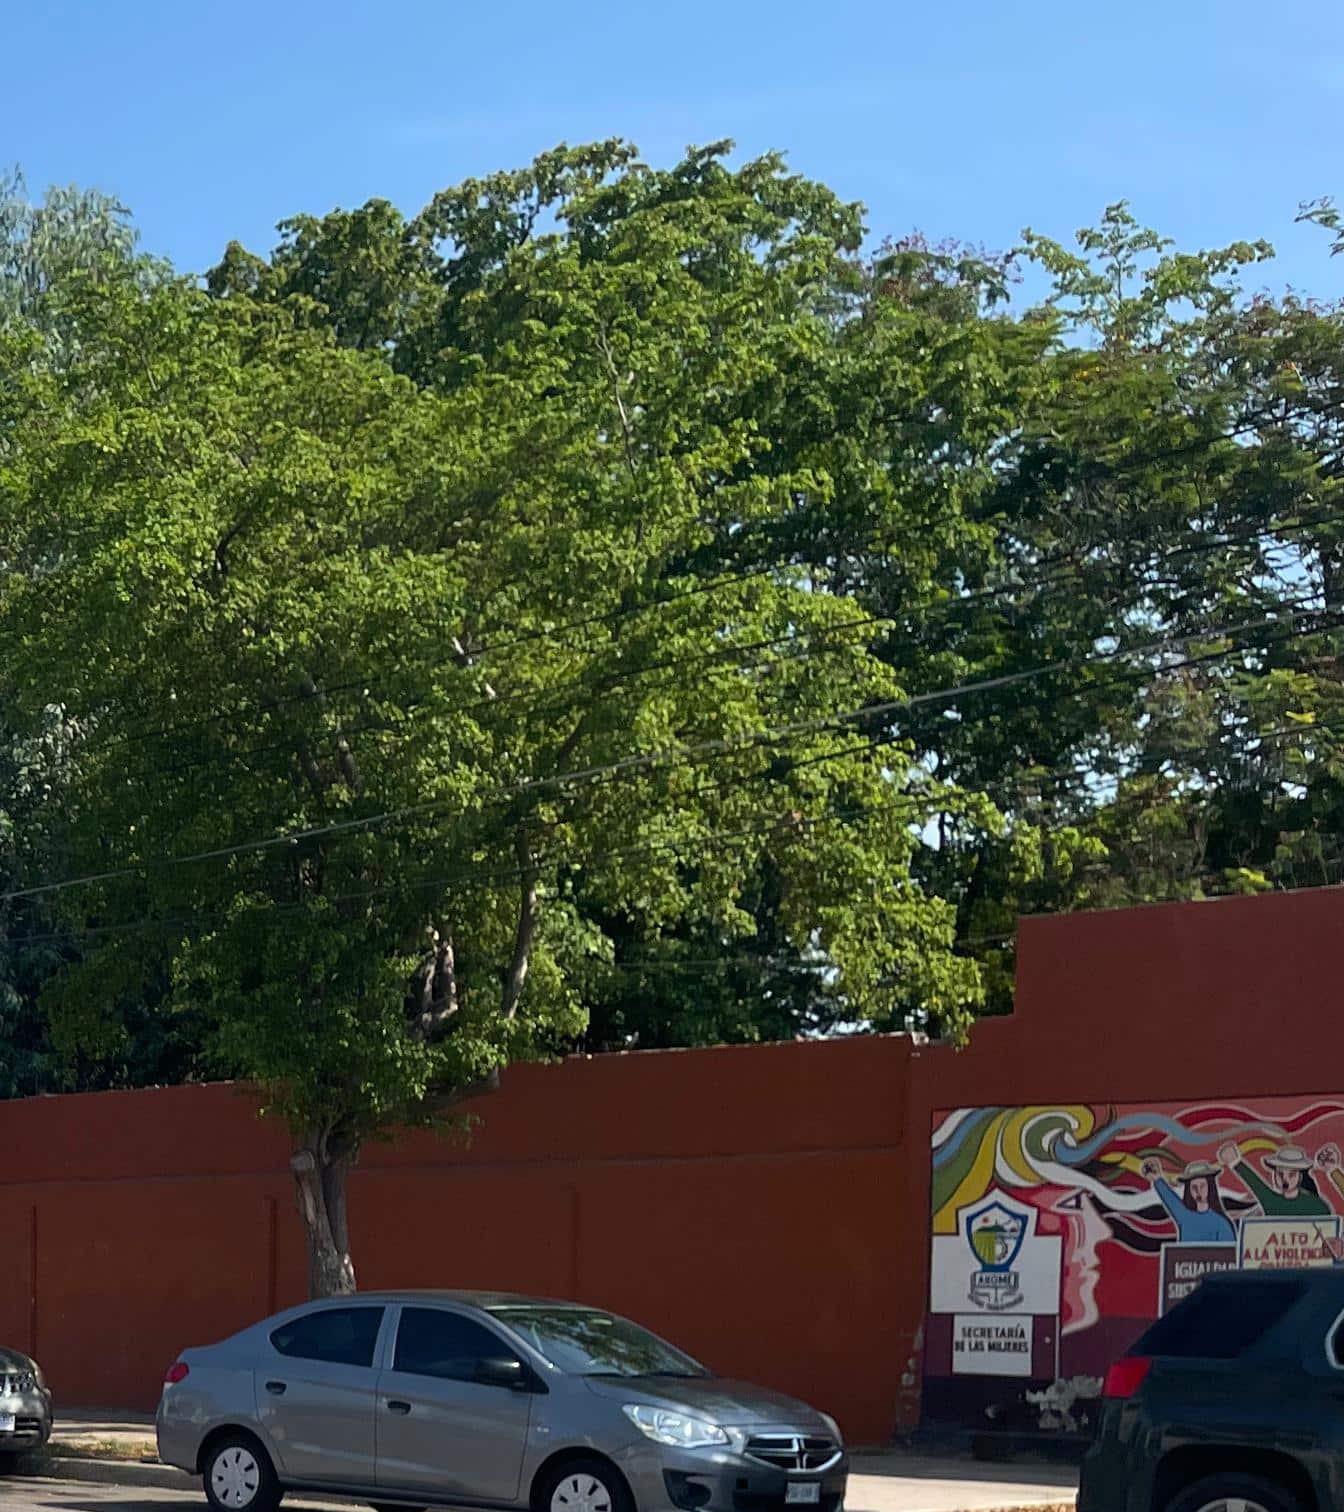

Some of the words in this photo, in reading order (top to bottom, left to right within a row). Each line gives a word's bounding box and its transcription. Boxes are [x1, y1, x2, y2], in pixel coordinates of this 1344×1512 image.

[1266, 1232, 1308, 1246] ALTO
[1255, 1249, 1269, 1261] LA
[962, 1323, 1025, 1339] SECRETARÍA
[968, 1341, 985, 1353] LAS
[988, 1341, 1029, 1354] MUJERES
